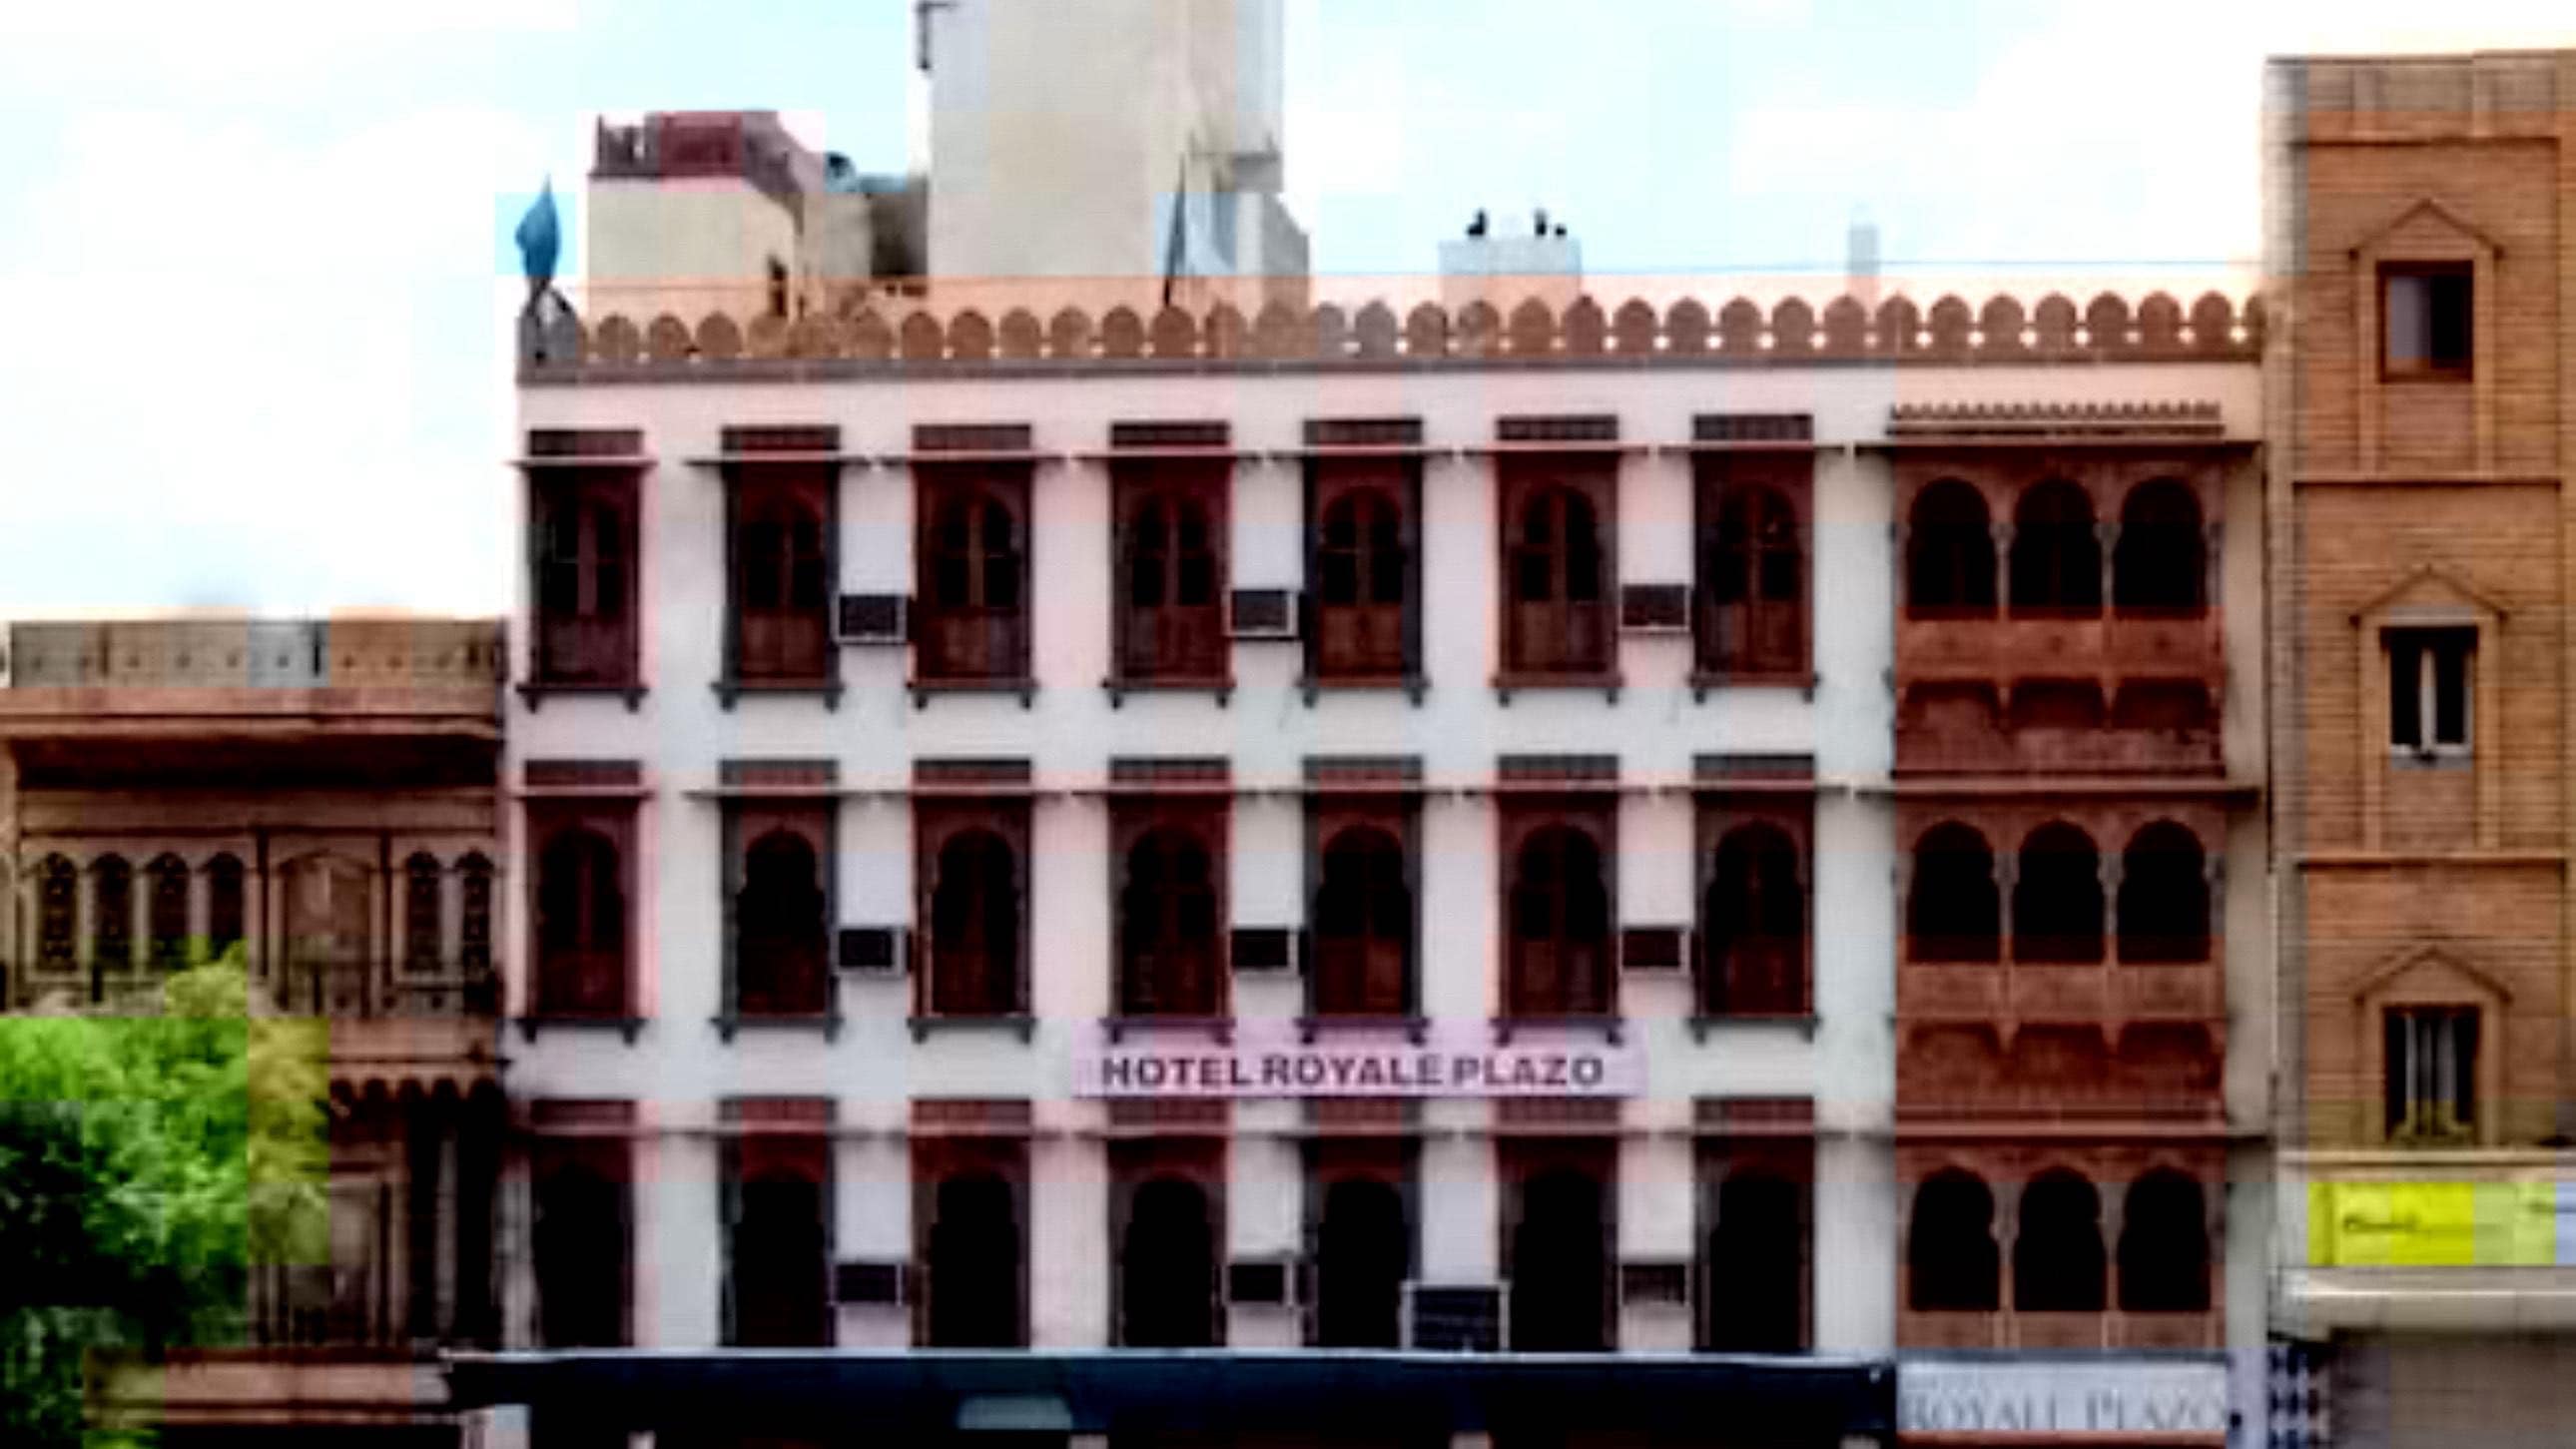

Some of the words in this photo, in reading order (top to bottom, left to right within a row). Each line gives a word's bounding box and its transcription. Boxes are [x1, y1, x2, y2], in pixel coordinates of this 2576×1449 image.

[1101, 1057, 1252, 1086] HOTEL
[1262, 1056, 1444, 1086] ROYALE
[1453, 1057, 1605, 1086] PLAZO
